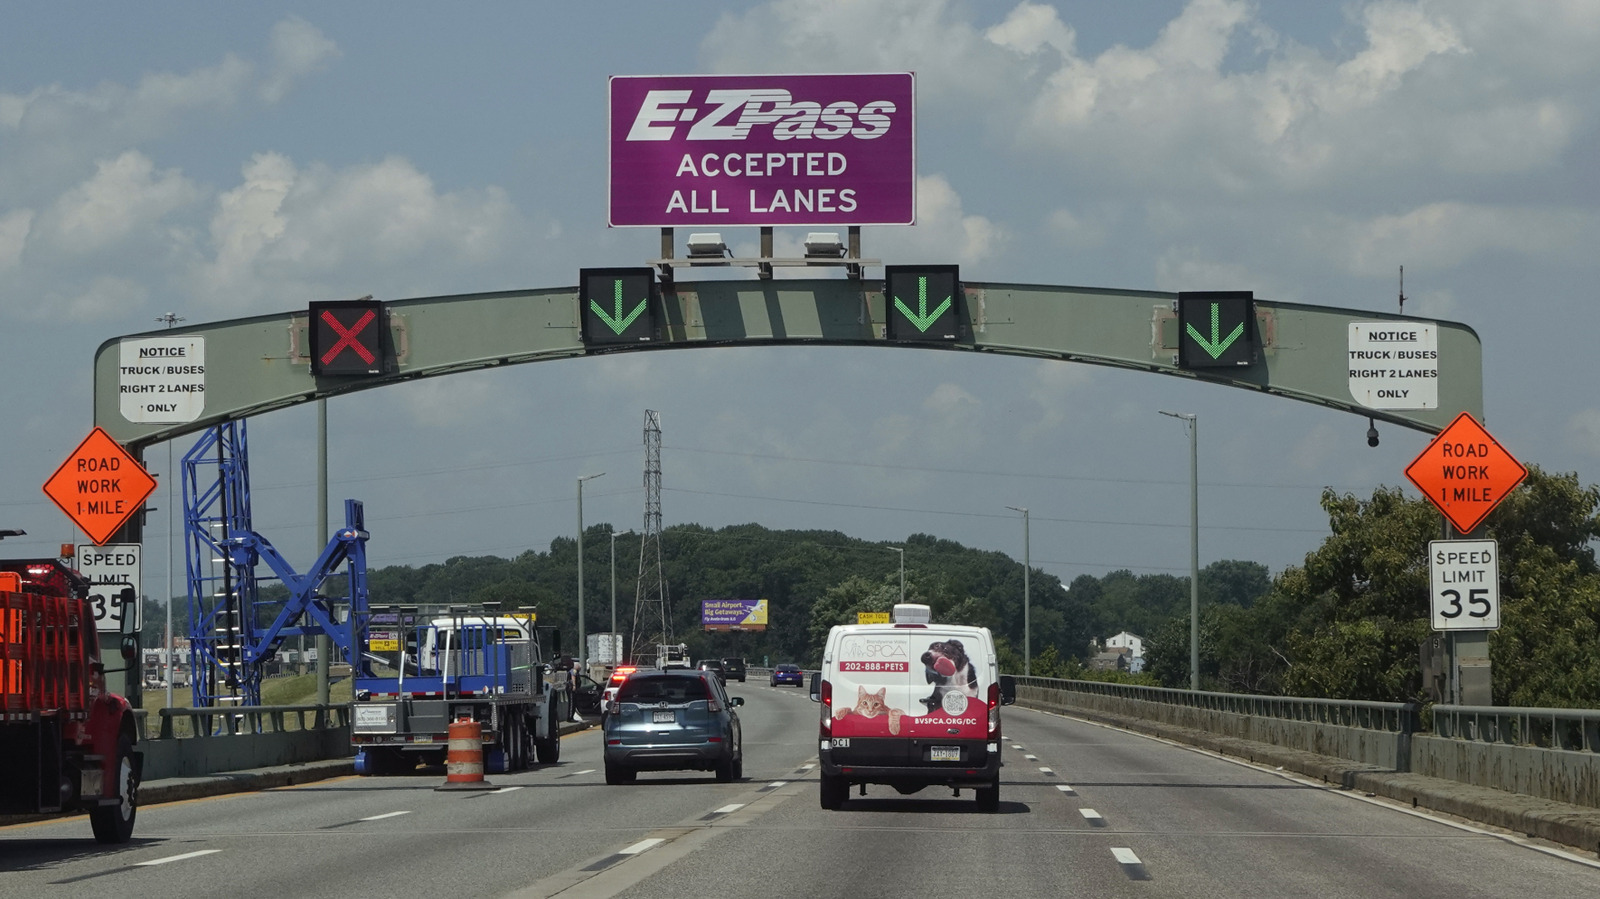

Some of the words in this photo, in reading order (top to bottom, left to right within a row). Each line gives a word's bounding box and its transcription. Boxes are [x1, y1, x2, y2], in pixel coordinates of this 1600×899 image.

[625, 88, 897, 141] E-ZPass
[675, 152, 847, 177] ACCEPTED
[665, 190, 730, 213] ALL
[750, 188, 858, 213] LANES
[1368, 331, 1417, 341] NOTICE
[139, 347, 186, 357] NOTICE
[1349, 369, 1386, 378] RIGHT
[1389, 369, 1396, 378] 2
[1398, 369, 1437, 378] LANES
[120, 384, 156, 394] RIGHT
[158, 384, 165, 393] 2
[166, 383, 205, 393] LANES
[1377, 389, 1409, 398] ONLY
[146, 403, 177, 413] ONLY
[1443, 443, 1489, 458] ROAD
[77, 457, 120, 472] ROAD
[1443, 465, 1489, 480] WORK
[77, 479, 121, 494] WORK
[1441, 487, 1446, 502] 1
[1453, 487, 1492, 502] MILE
[76, 501, 82, 516] 1
[87, 500, 124, 515] MILE
[83, 553, 136, 566] SPEED
[1436, 552, 1492, 565] SPEED
[1443, 570, 1486, 583] LIMIT
[1440, 588, 1492, 619] 35
[866, 644, 907, 657] SPCA
[845, 662, 904, 671] 202-888-PETS
[914, 717, 977, 726] BVSPCA.ORG/DC
[832, 738, 849, 747] DC1
